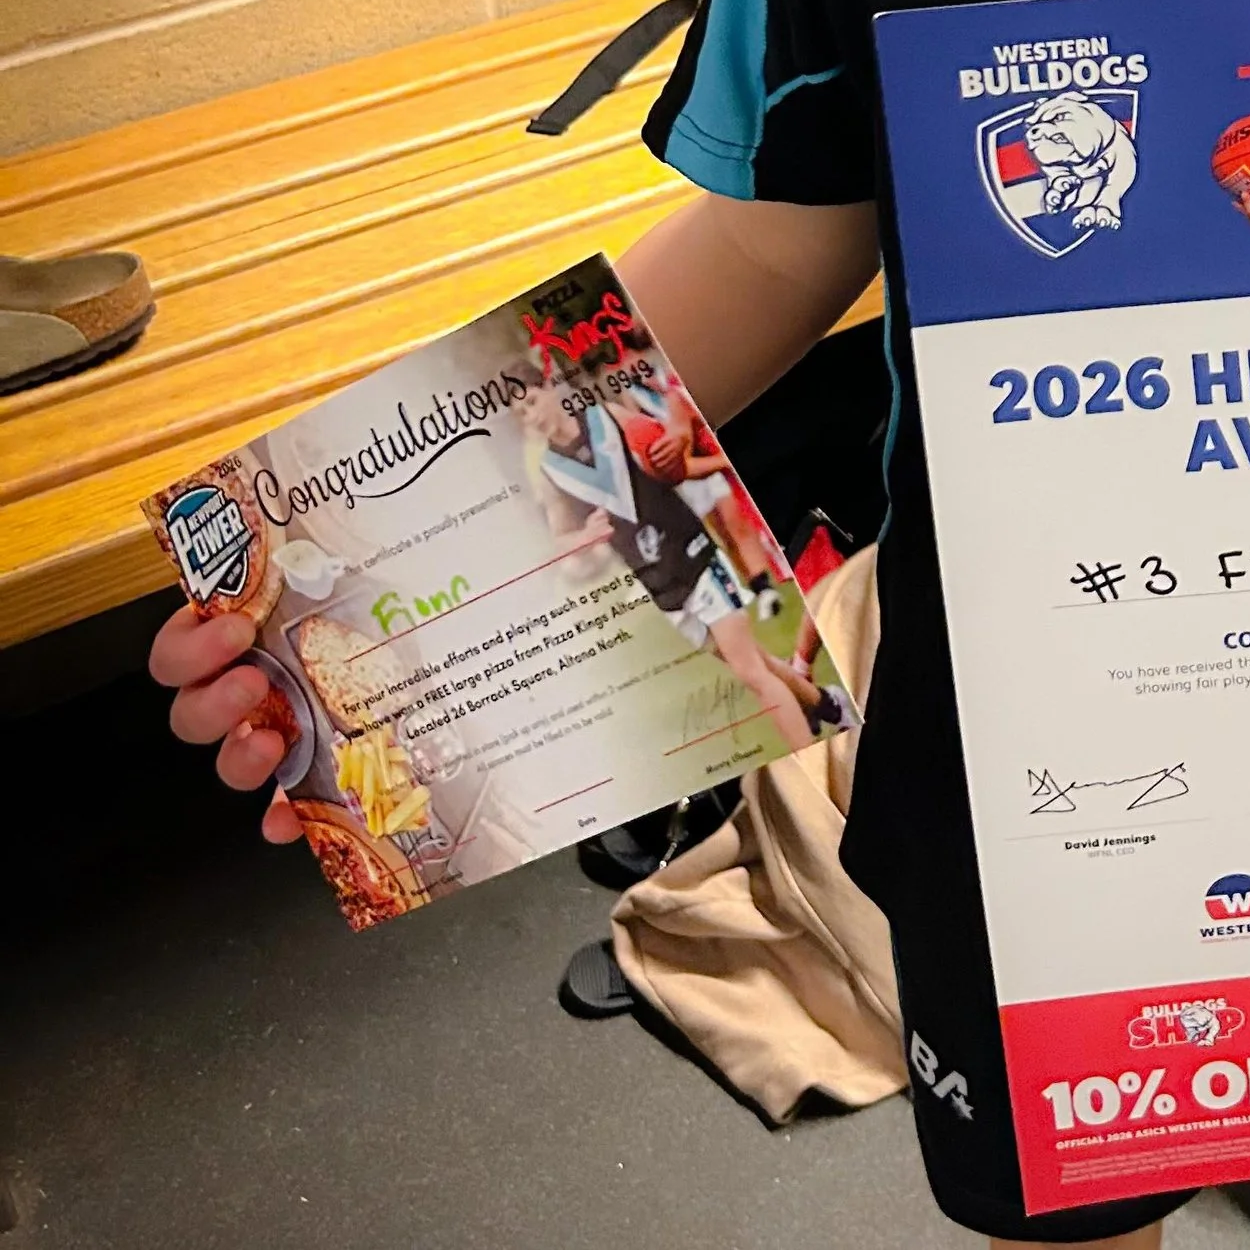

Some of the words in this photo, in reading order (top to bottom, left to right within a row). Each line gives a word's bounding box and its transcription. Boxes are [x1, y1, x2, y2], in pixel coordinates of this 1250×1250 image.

[993, 36, 1109, 64] WESTERN
[959, 53, 1149, 99] BULLDOGS
[561, 385, 603, 418] 9391
[988, 356, 1170, 425] 2026
[253, 369, 528, 527] Congratulations
[421, 512, 459, 540] proudly
[458, 488, 509, 521] presented
[168, 507, 249, 575] POWER
[343, 699, 360, 714] For
[361, 688, 386, 708] your
[385, 661, 441, 694] incredible
[441, 643, 480, 668] efforts
[480, 631, 504, 650] and
[503, 609, 549, 643] playing
[547, 596, 576, 617] such
[579, 594, 587, 604] a
[588, 576, 623, 602] great
[363, 711, 390, 731] have
[393, 703, 414, 719] won
[417, 699, 424, 708] a
[425, 684, 450, 703] FREE
[451, 669, 482, 694] large
[482, 655, 515, 680] pizza
[514, 641, 542, 661] from
[543, 627, 574, 648] Pizza
[575, 611, 610, 637] Kings
[610, 591, 651, 617] Altona
[1107, 668, 1133, 681] You
[1137, 665, 1170, 678] have
[1175, 658, 1232, 676] received
[405, 712, 450, 739] Located
[451, 704, 465, 718] 26
[466, 682, 511, 711] Borrack
[511, 663, 557, 694] Square,
[556, 643, 596, 670] Altona
[1135, 678, 1192, 695] showing
[1196, 675, 1218, 690] fair
[1064, 838, 1100, 851] David
[1103, 832, 1156, 849] Jennings
[1128, 1006, 1245, 1050] SHP
[1042, 1068, 1177, 1131] 10%
[1055, 1136, 1105, 1150] OFFICIAL
[1134, 1126, 1168, 1140] ASICS
[1168, 1119, 1221, 1135] WESTERN
